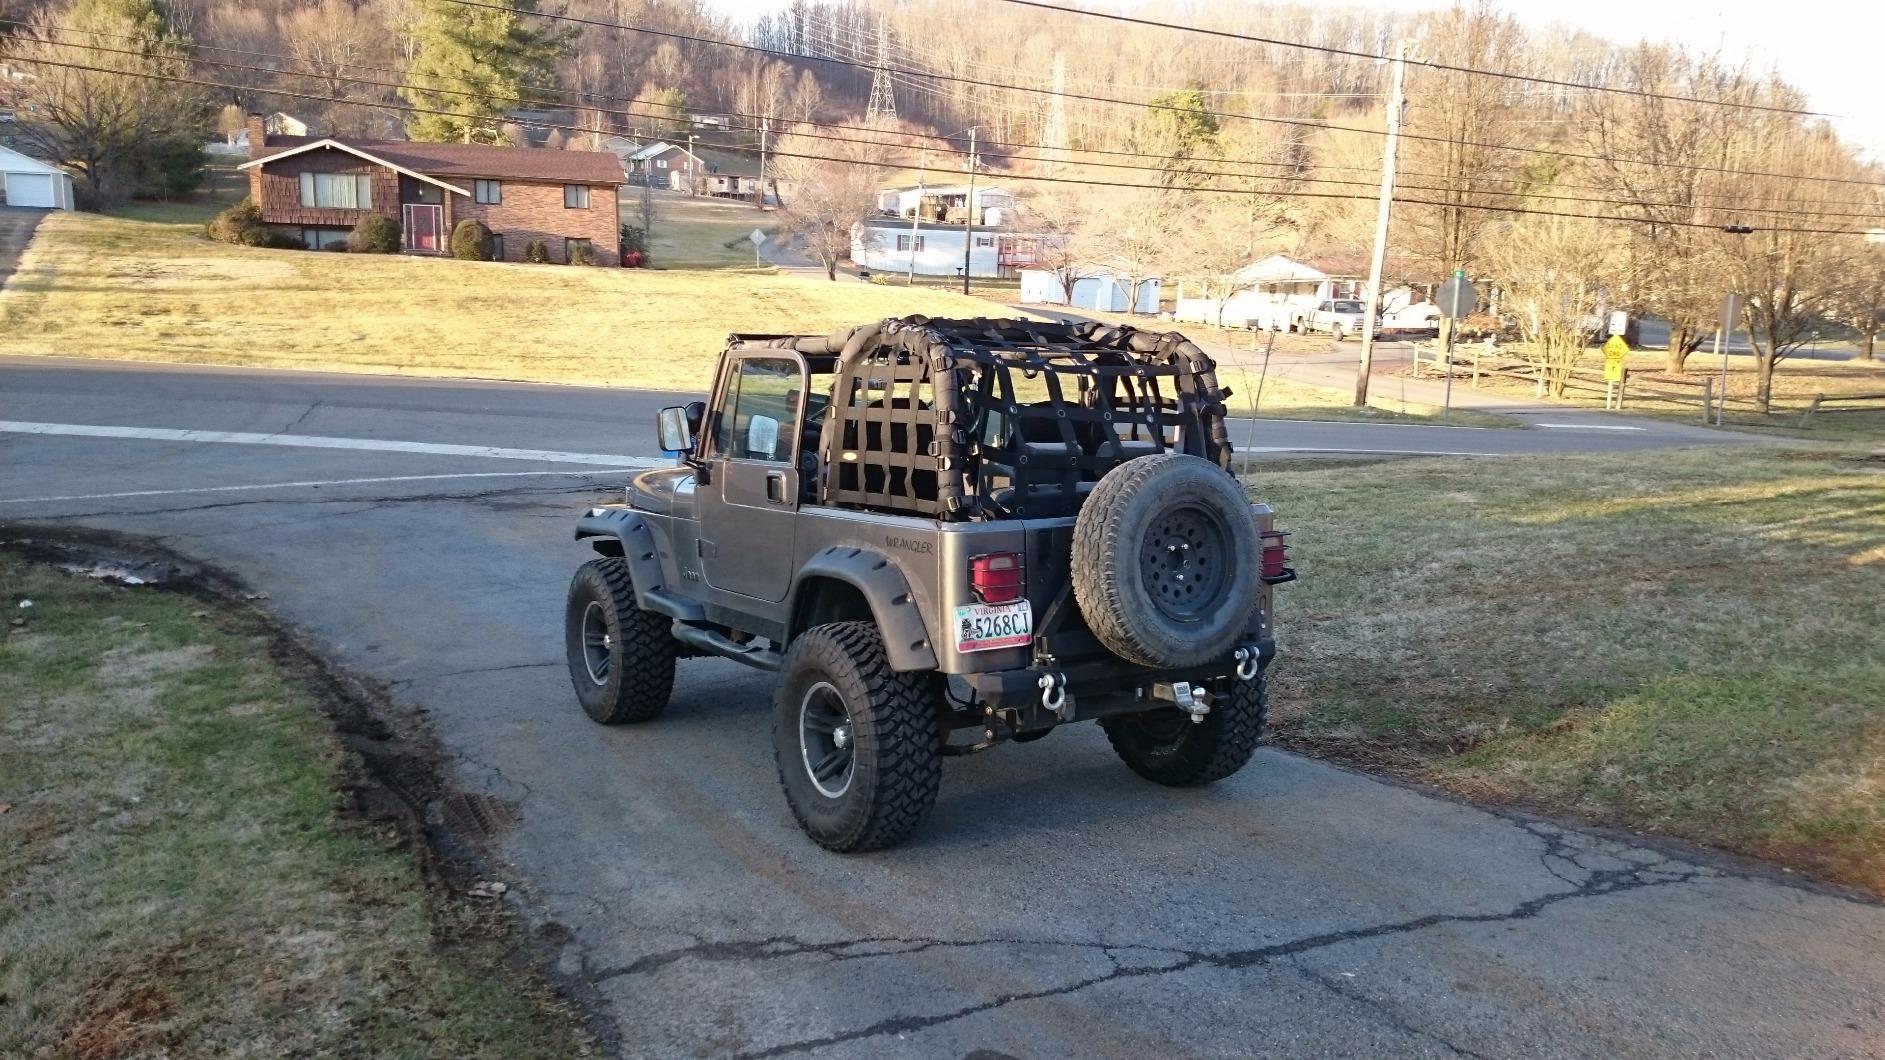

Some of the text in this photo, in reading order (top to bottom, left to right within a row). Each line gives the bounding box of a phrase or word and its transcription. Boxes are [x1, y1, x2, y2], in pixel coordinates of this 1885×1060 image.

[886, 536, 934, 556] WRANGLER
[974, 605, 1012, 616] VIRGINIA
[976, 612, 1029, 639] 5268CJ
